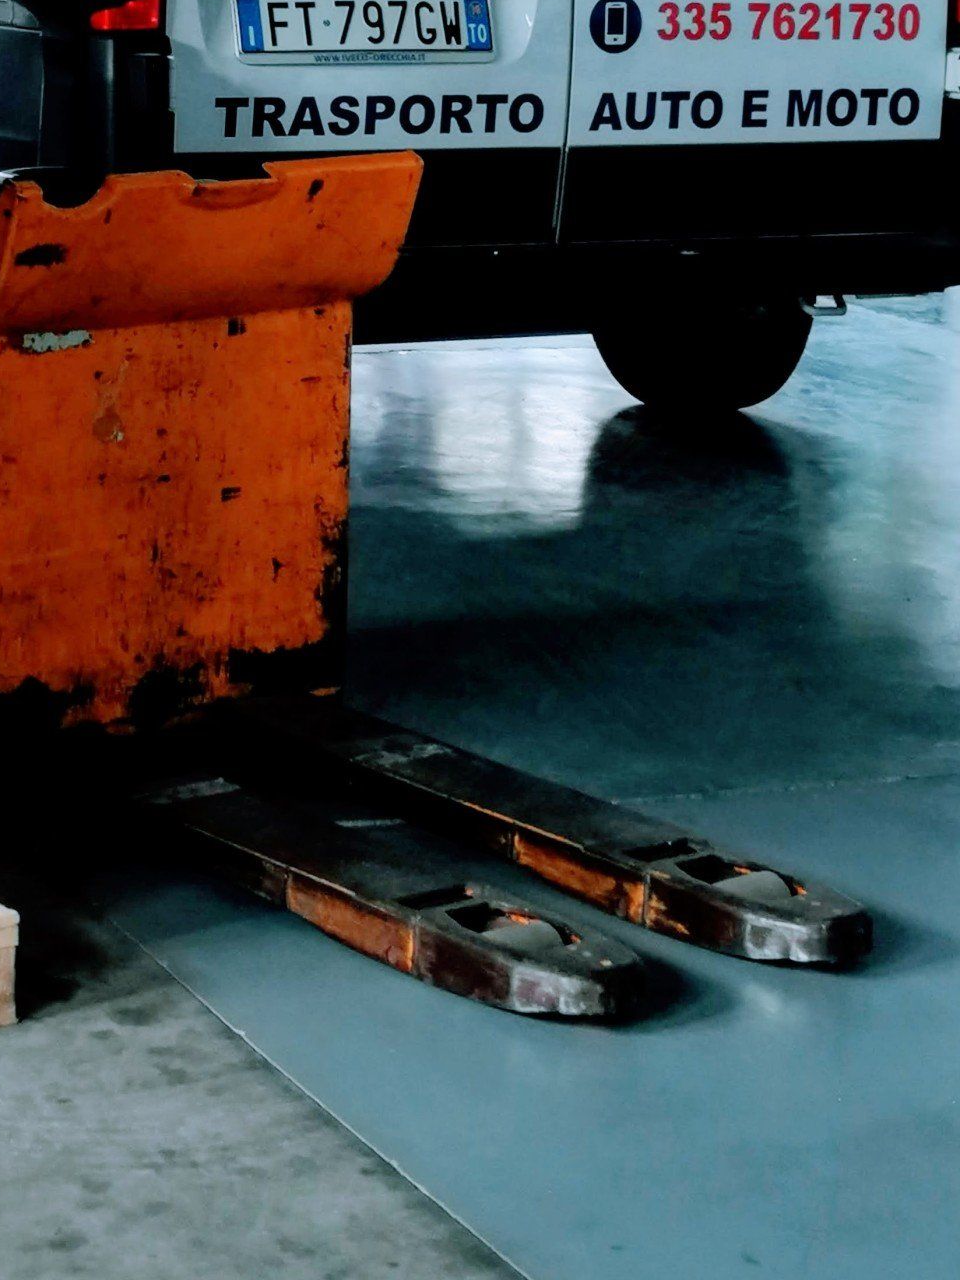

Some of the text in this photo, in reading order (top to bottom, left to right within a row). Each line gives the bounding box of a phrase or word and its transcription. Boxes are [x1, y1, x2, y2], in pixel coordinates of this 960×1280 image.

[267, 0, 462, 47] FT 797GW
[468, 22, 489, 44] TO
[657, 1, 922, 42] 335 7621730
[215, 87, 921, 138] TRASPORTO AUTO E MOTO
